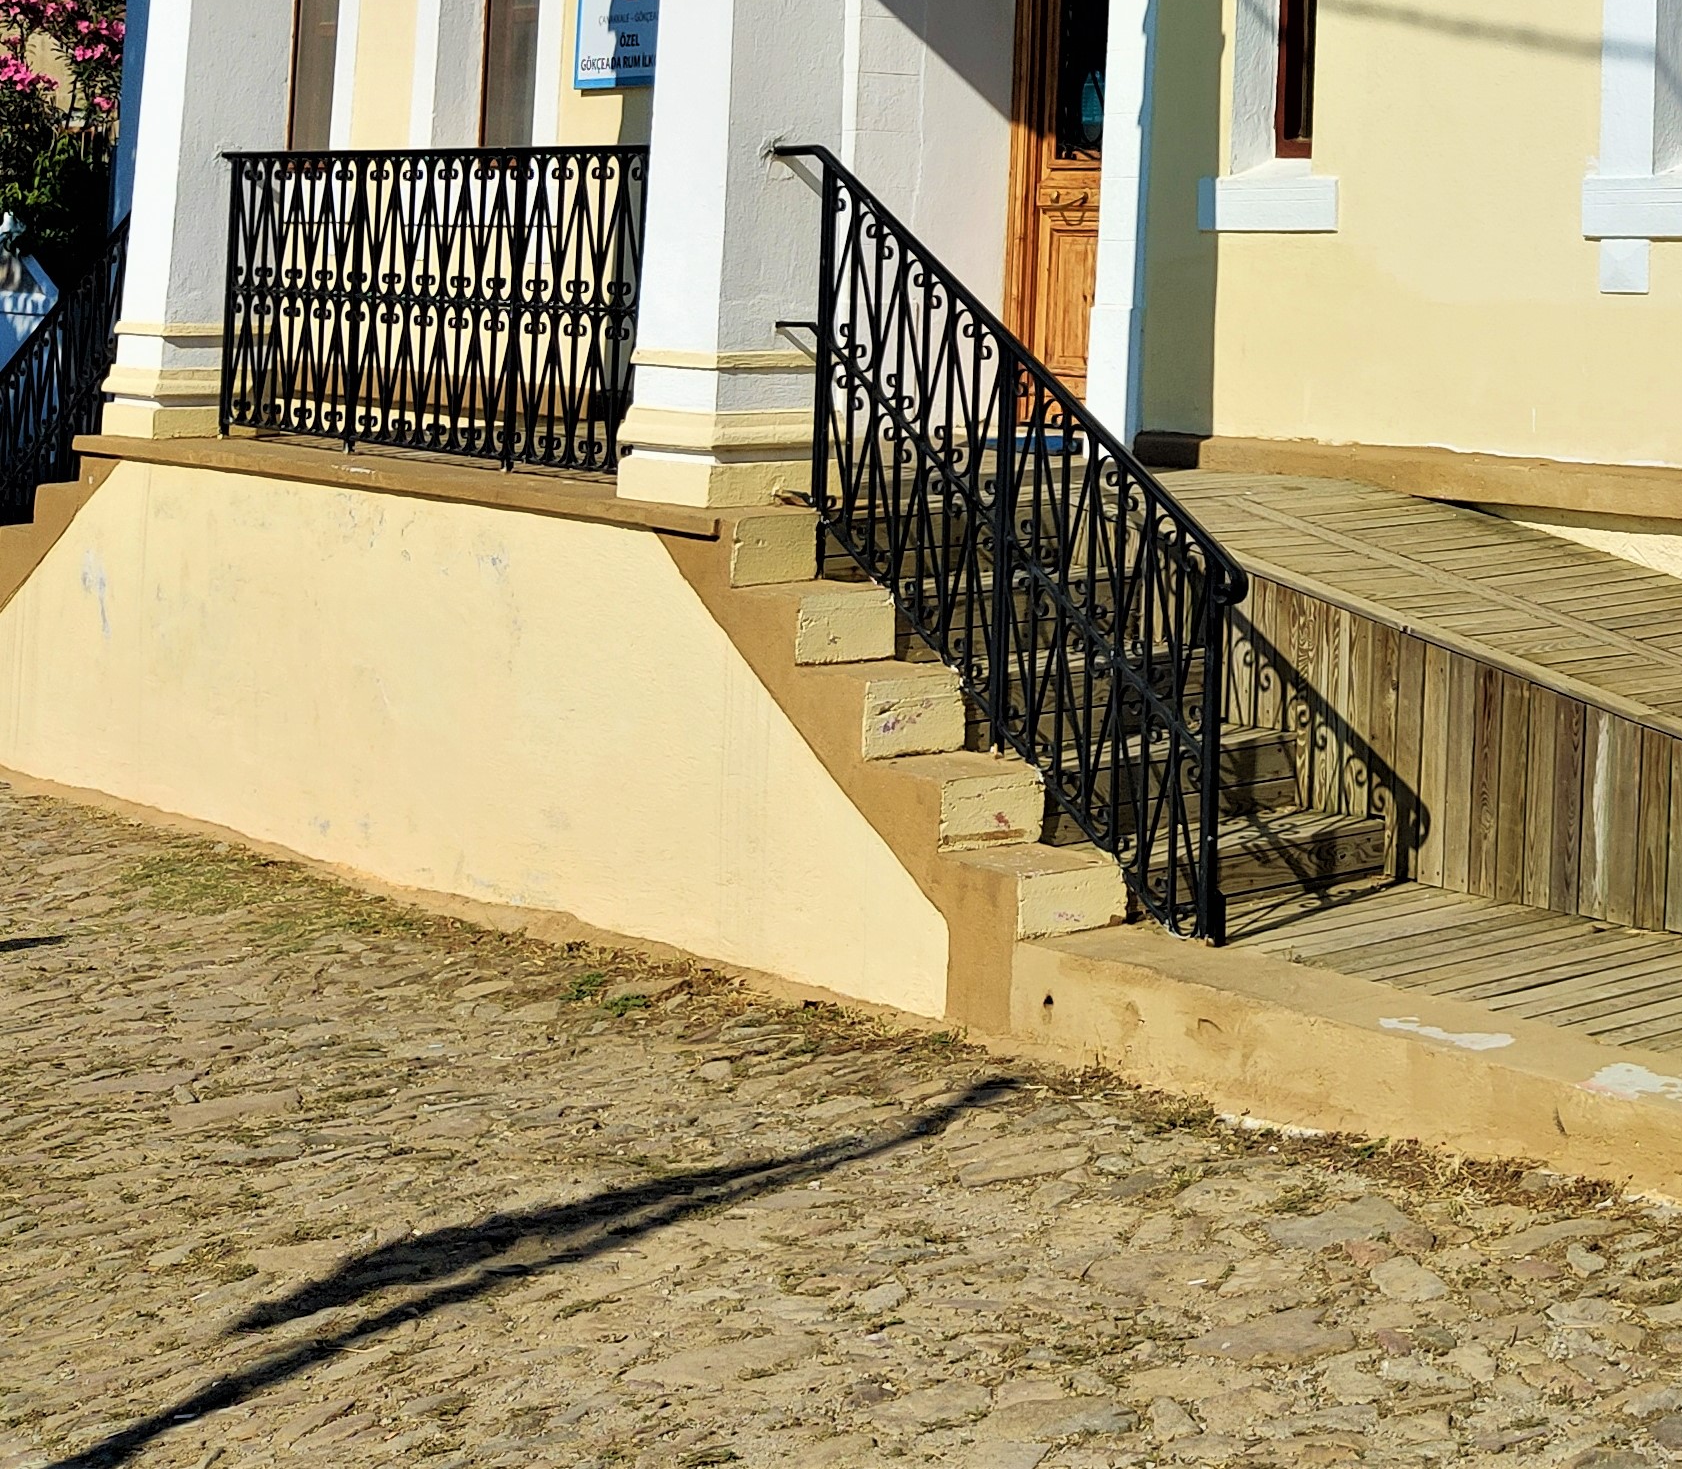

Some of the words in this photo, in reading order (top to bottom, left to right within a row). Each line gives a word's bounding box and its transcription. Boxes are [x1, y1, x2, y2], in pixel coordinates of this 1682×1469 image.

[619, 31, 640, 47] ÖZEL
[580, 55, 622, 74] GÖKÇEADA
[622, 55, 641, 69] RUM
